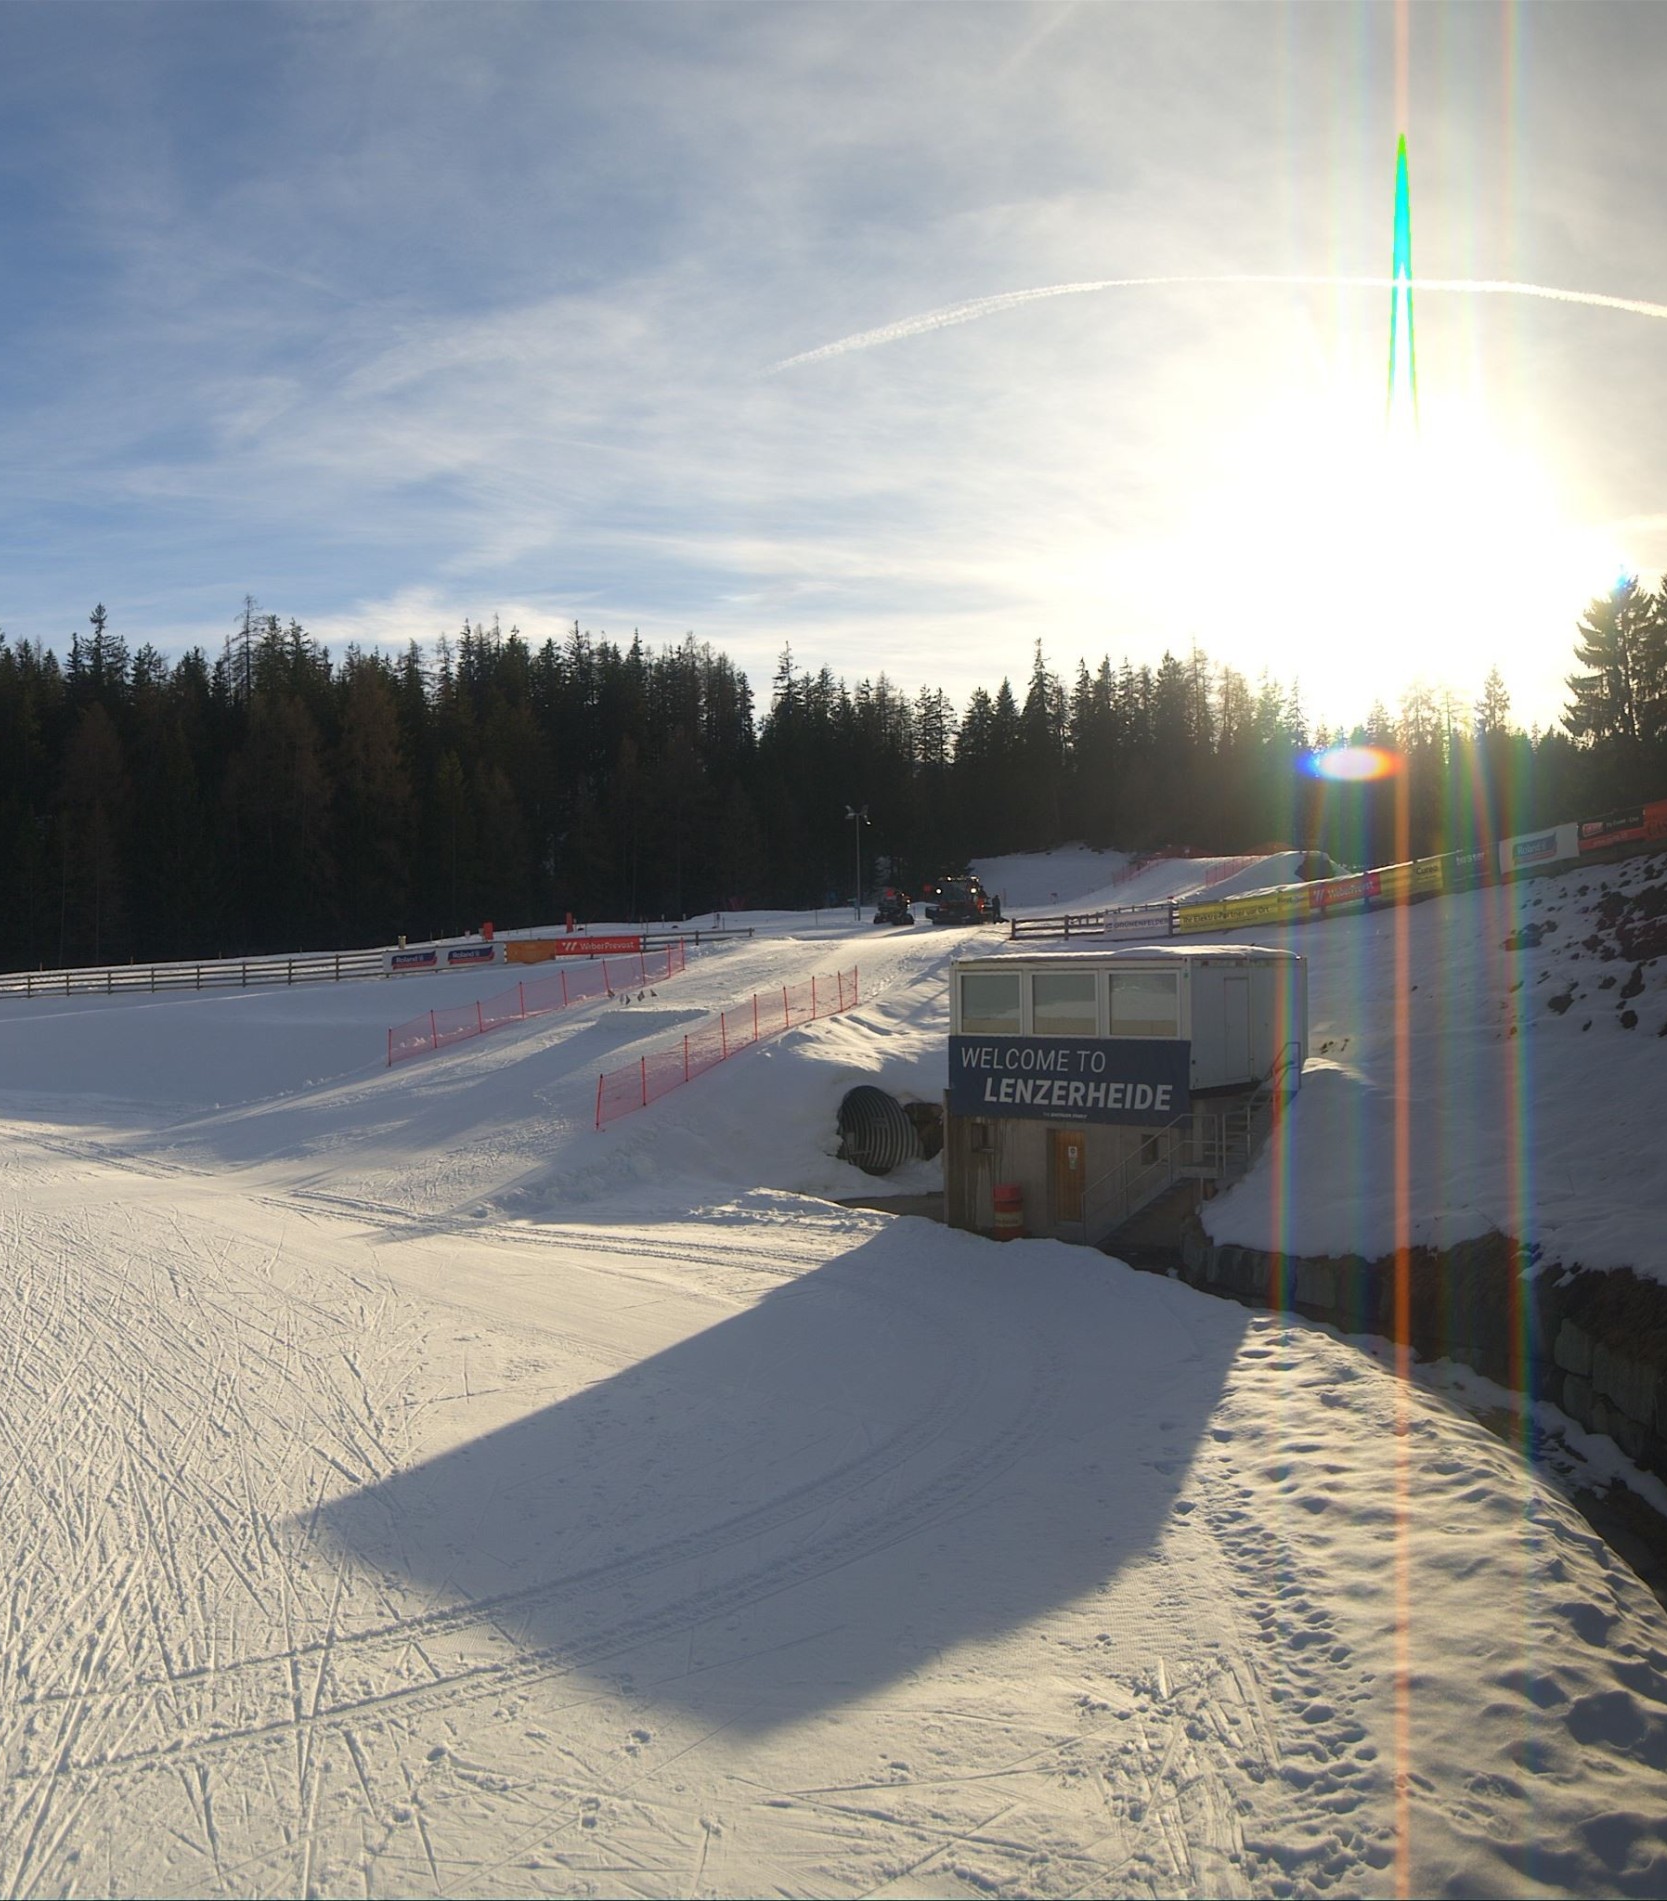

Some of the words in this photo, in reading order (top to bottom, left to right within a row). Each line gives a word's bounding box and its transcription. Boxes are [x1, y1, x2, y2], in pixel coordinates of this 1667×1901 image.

[961, 1048, 1070, 1072] WELCOME
[1077, 1050, 1106, 1073] TO
[984, 1077, 1173, 1111] LENZERHEIDE
